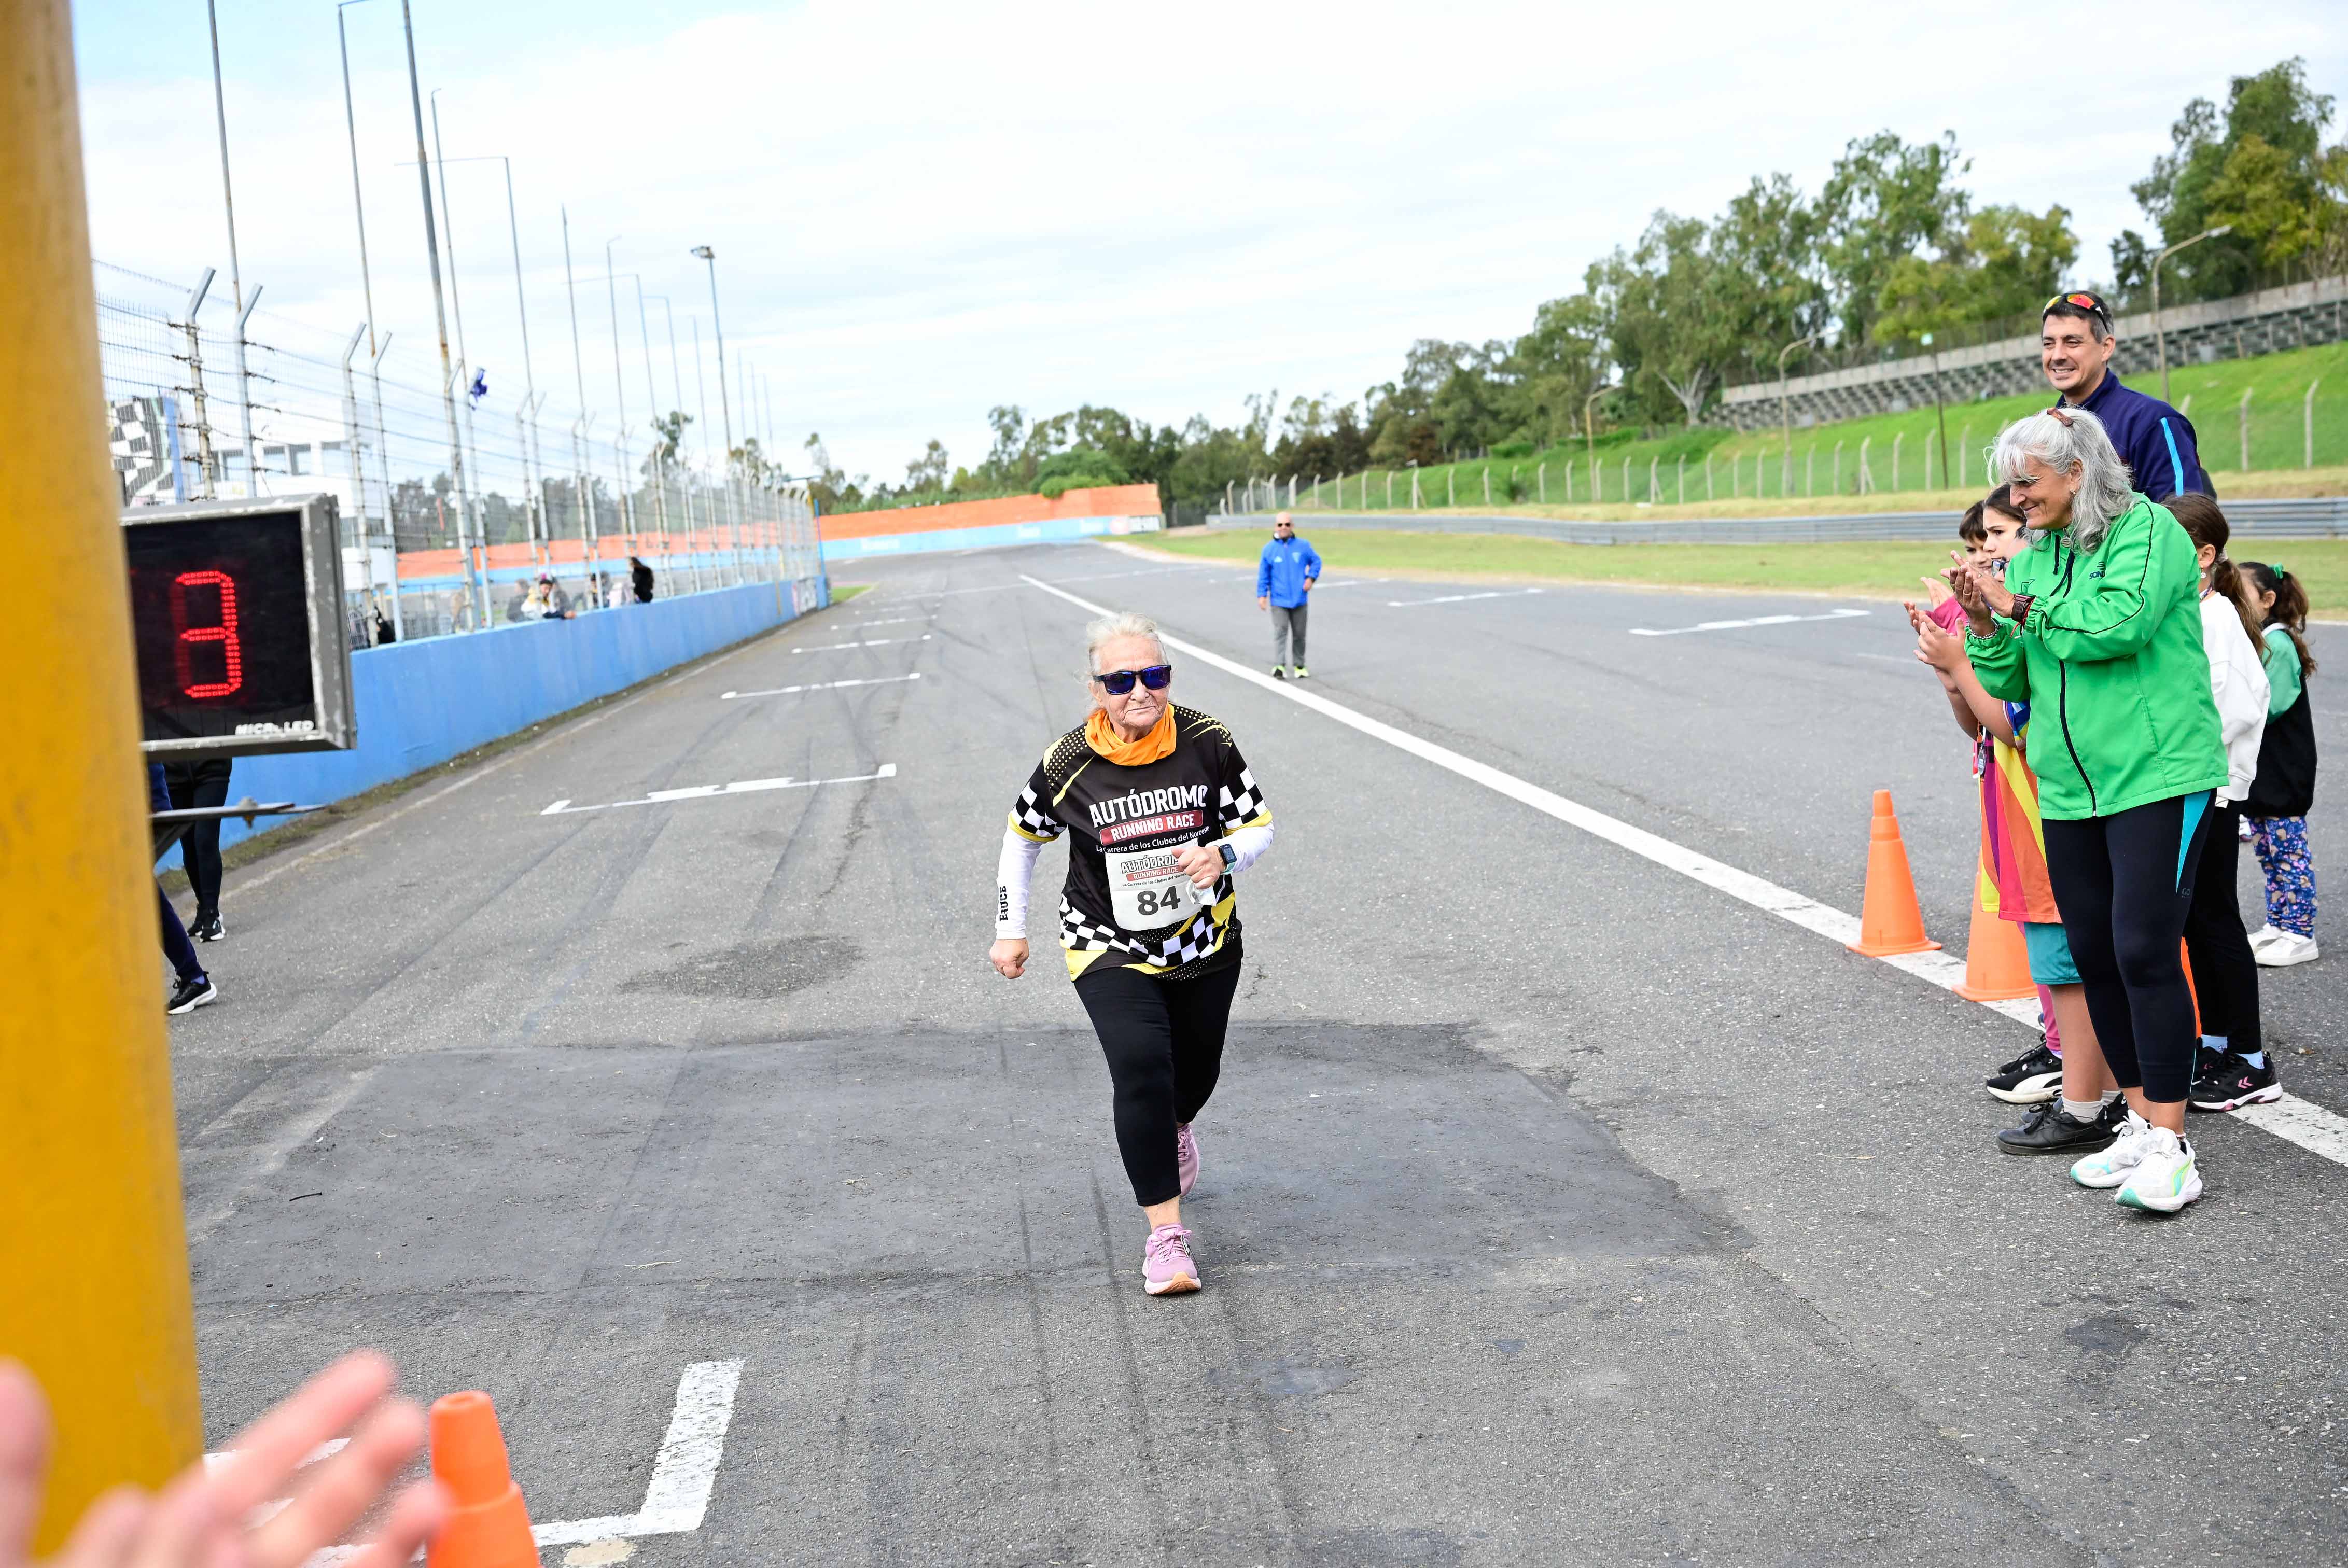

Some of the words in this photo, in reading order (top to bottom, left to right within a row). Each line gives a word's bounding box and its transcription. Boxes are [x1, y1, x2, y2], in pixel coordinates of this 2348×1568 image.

[2089, 571, 2105, 580] SOND
[175, 569, 243, 698] 3
[1089, 785, 1208, 828] AUTÓDROMO
[1096, 844, 1103, 852] La
[1152, 837, 1177, 847] Clubes
[1178, 832, 1189, 842] del
[1189, 825, 1209, 839] Noroeste
[1110, 818, 1163, 841] RUNNING
[1166, 814, 1195, 829] RACE
[1121, 855, 1179, 874] AUTÓDROM
[1133, 869, 1161, 880] RUNNING
[1162, 866, 1178, 875] RACE
[1137, 885, 1181, 916] 84
